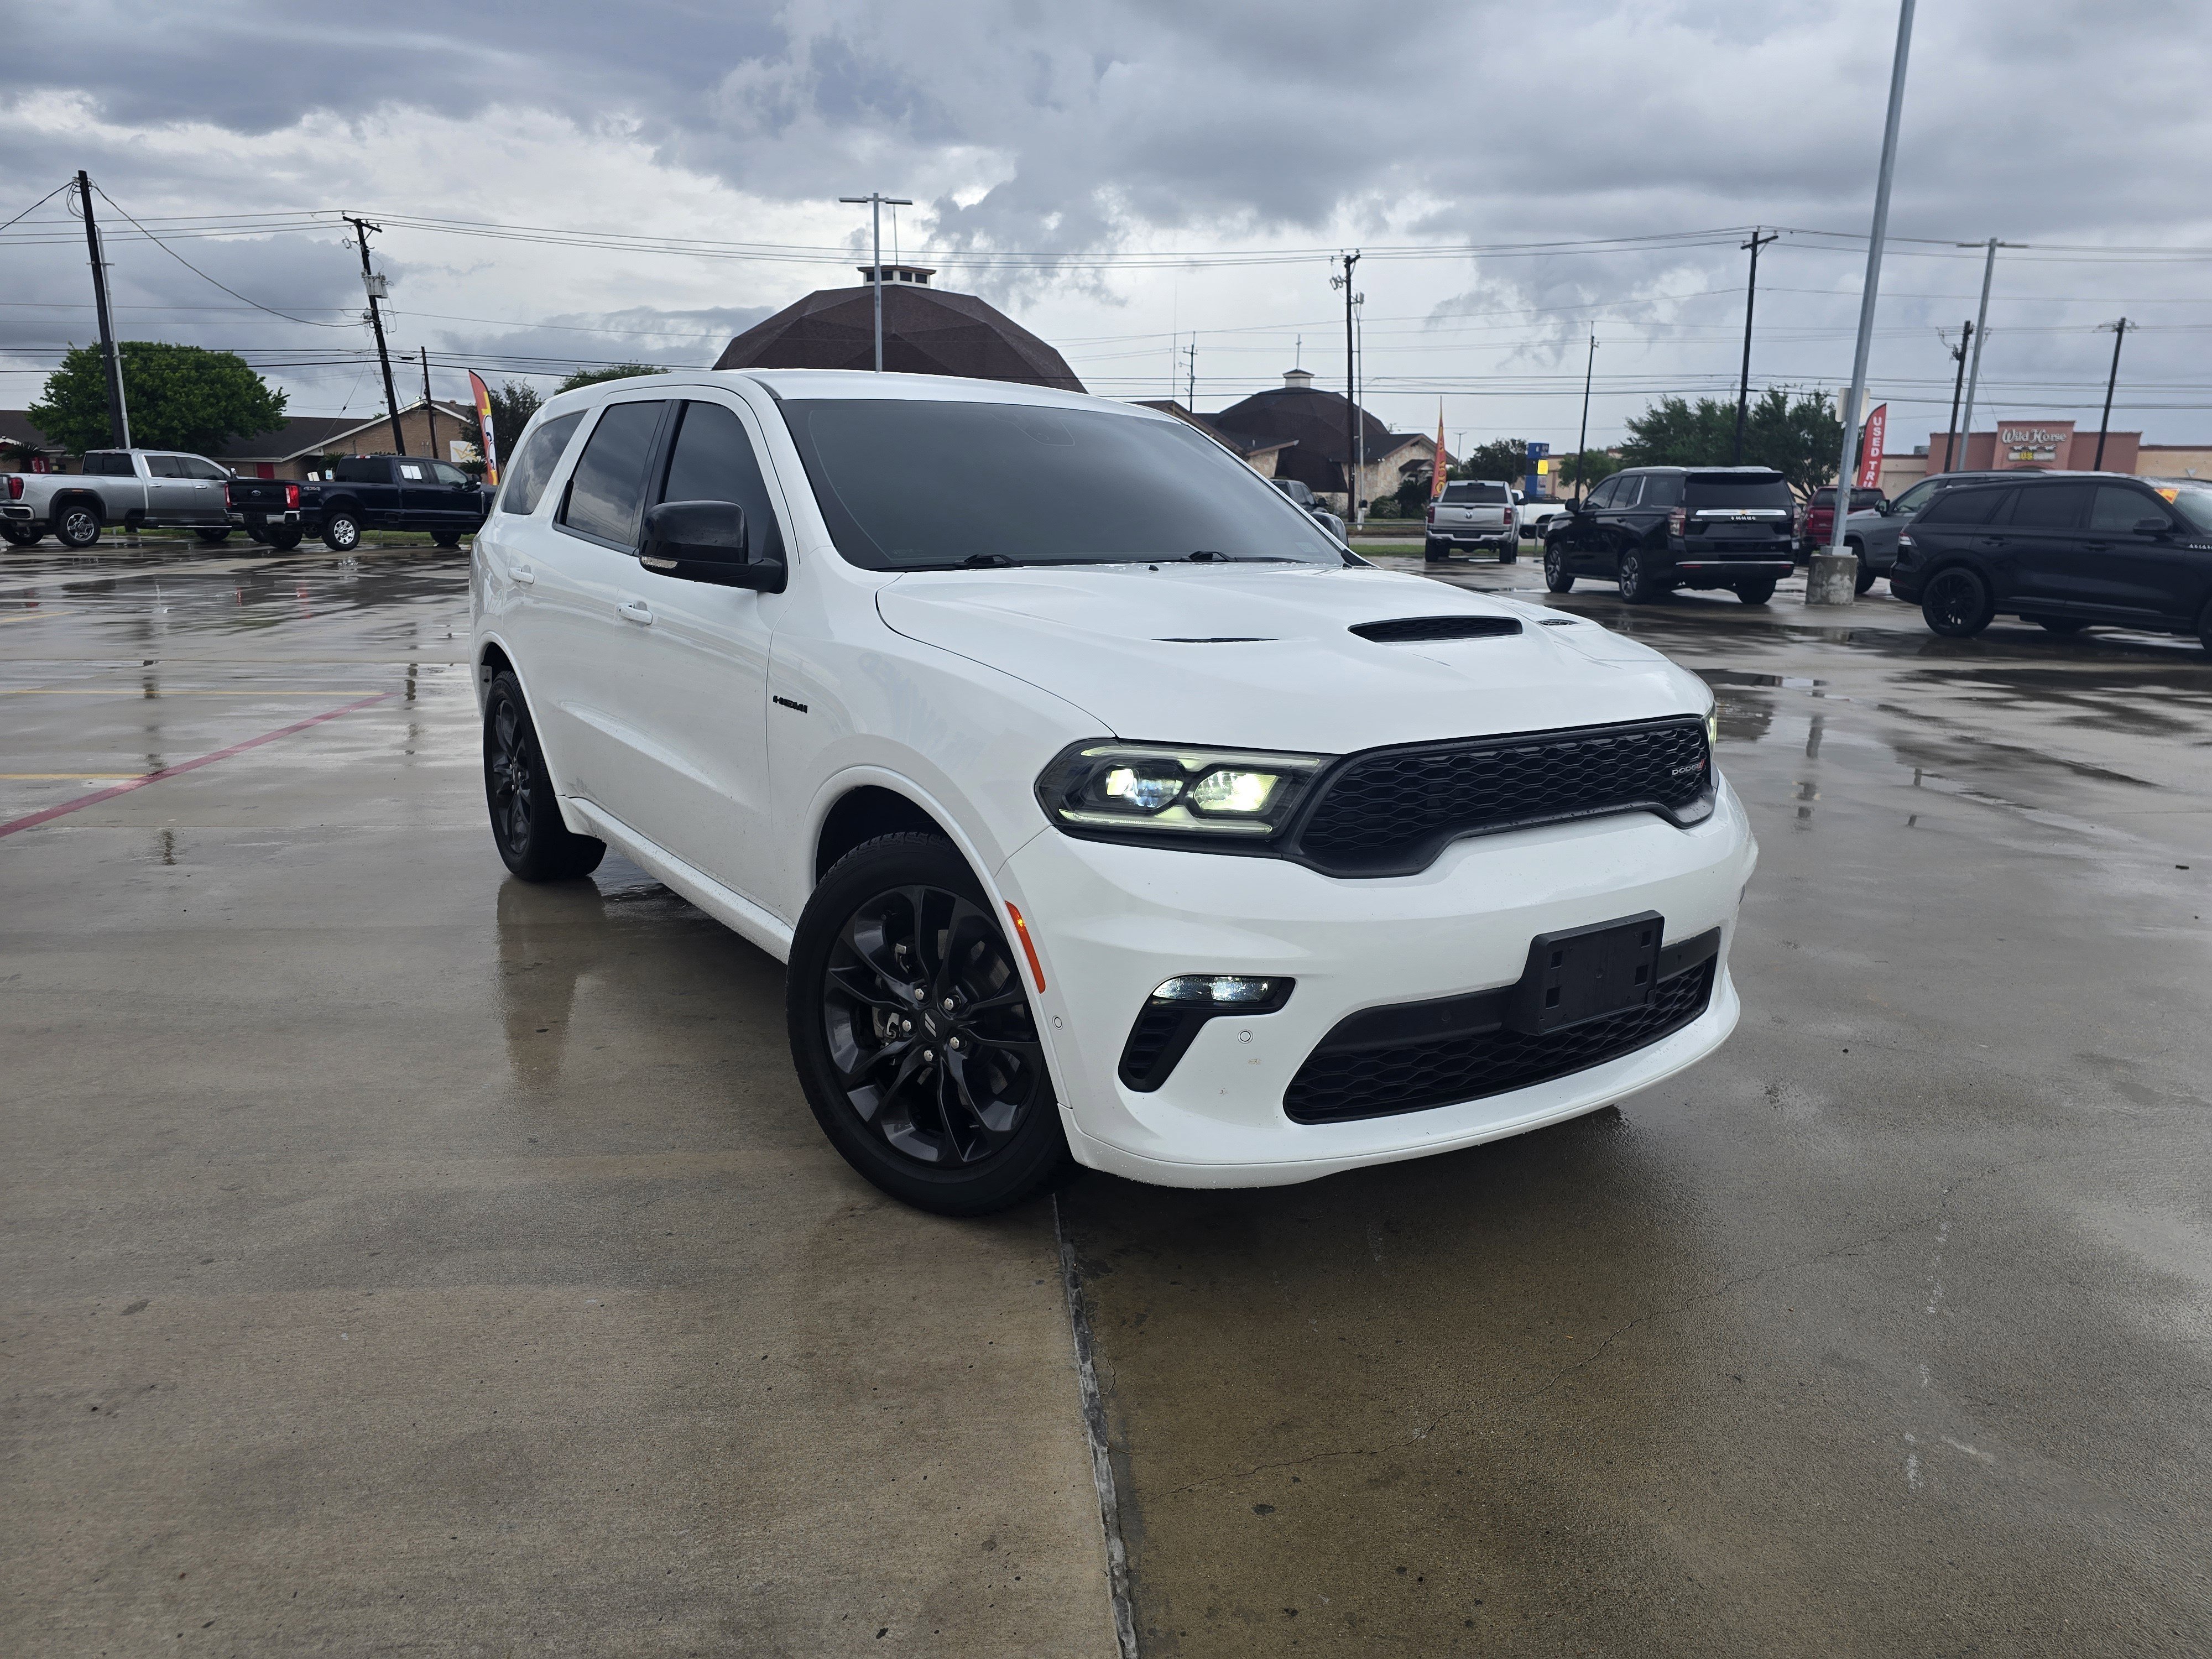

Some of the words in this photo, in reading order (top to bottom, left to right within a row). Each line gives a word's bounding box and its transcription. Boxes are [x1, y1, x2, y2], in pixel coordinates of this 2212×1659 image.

[1870, 416, 1882, 457] USED
[2002, 429, 2029, 443] Wild
[2029, 429, 2067, 444] Horse
